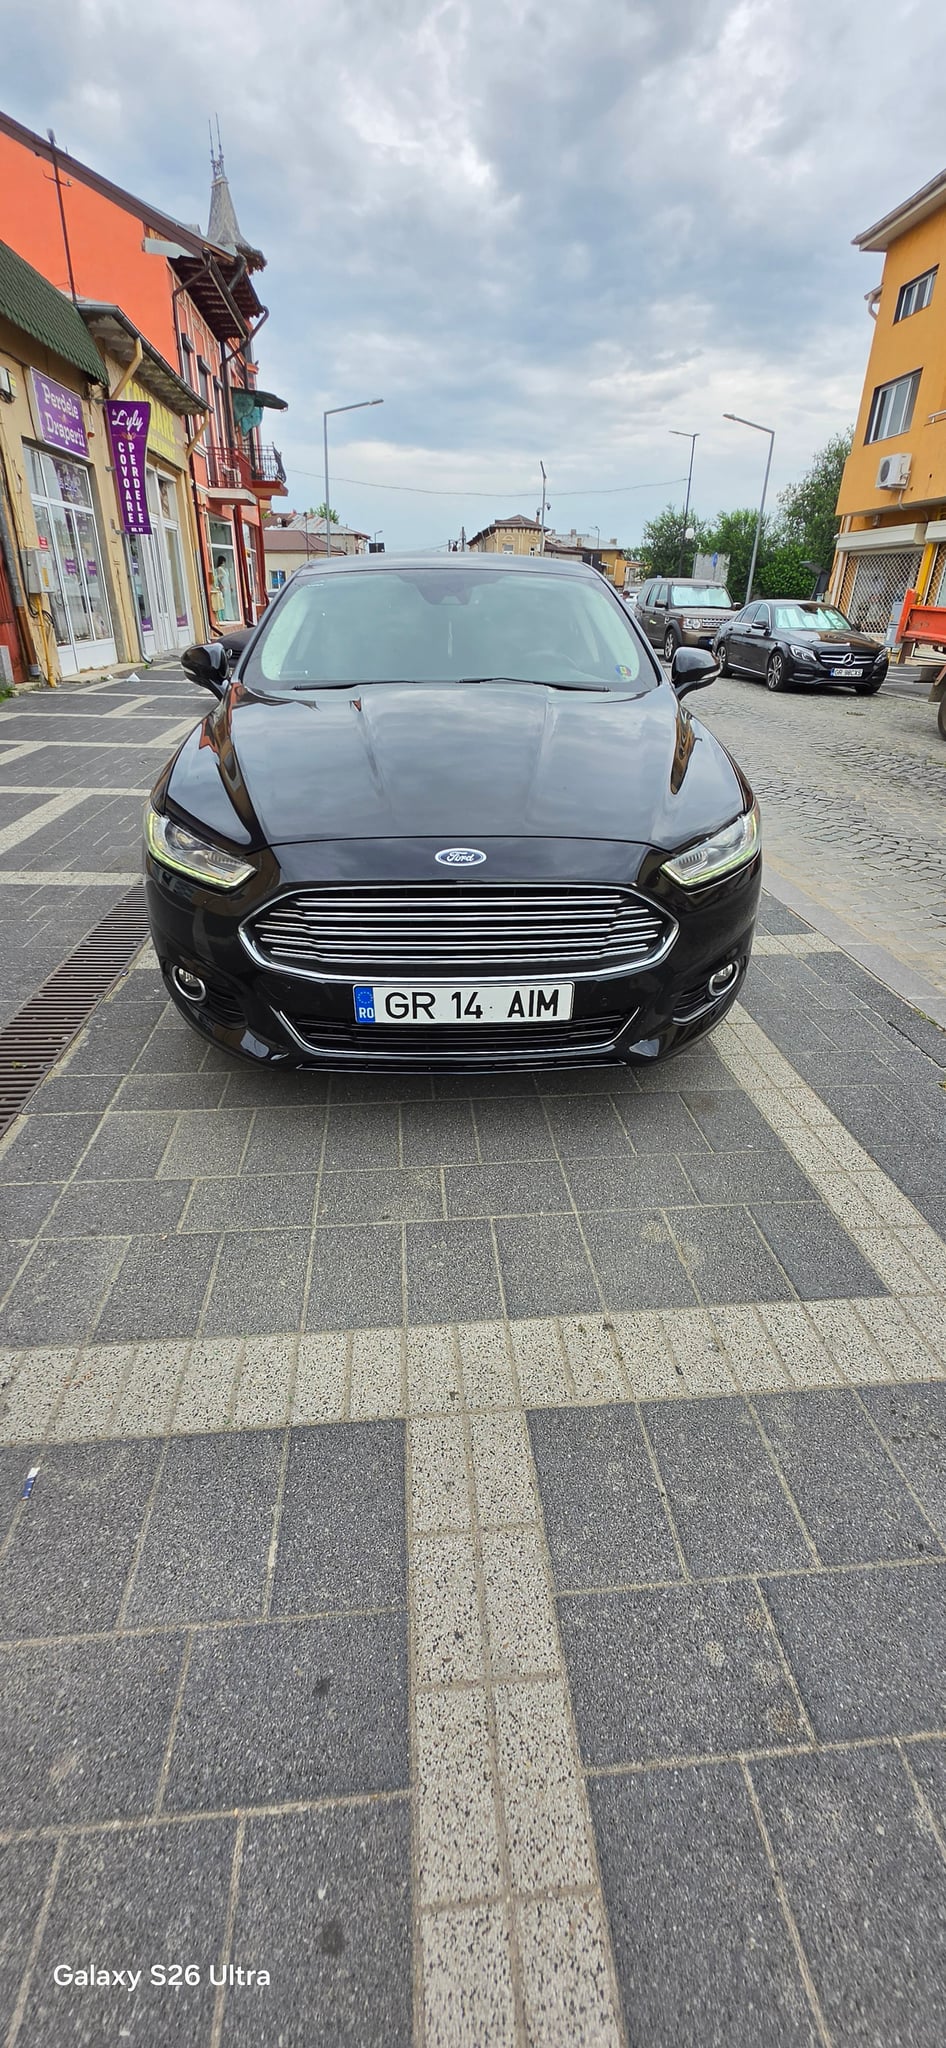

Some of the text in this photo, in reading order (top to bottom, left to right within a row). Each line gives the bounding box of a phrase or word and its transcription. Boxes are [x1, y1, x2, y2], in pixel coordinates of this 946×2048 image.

[41, 382, 79, 420] Perdele
[44, 411, 85, 448] Draperii
[112, 409, 143, 432] Lyly
[118, 442, 134, 523] COVOARE
[128, 442, 144, 523] PERDELE
[446, 851, 475, 862] Ford
[359, 1007, 374, 1019] RO
[385, 989, 559, 1020] GR 14 AIM
